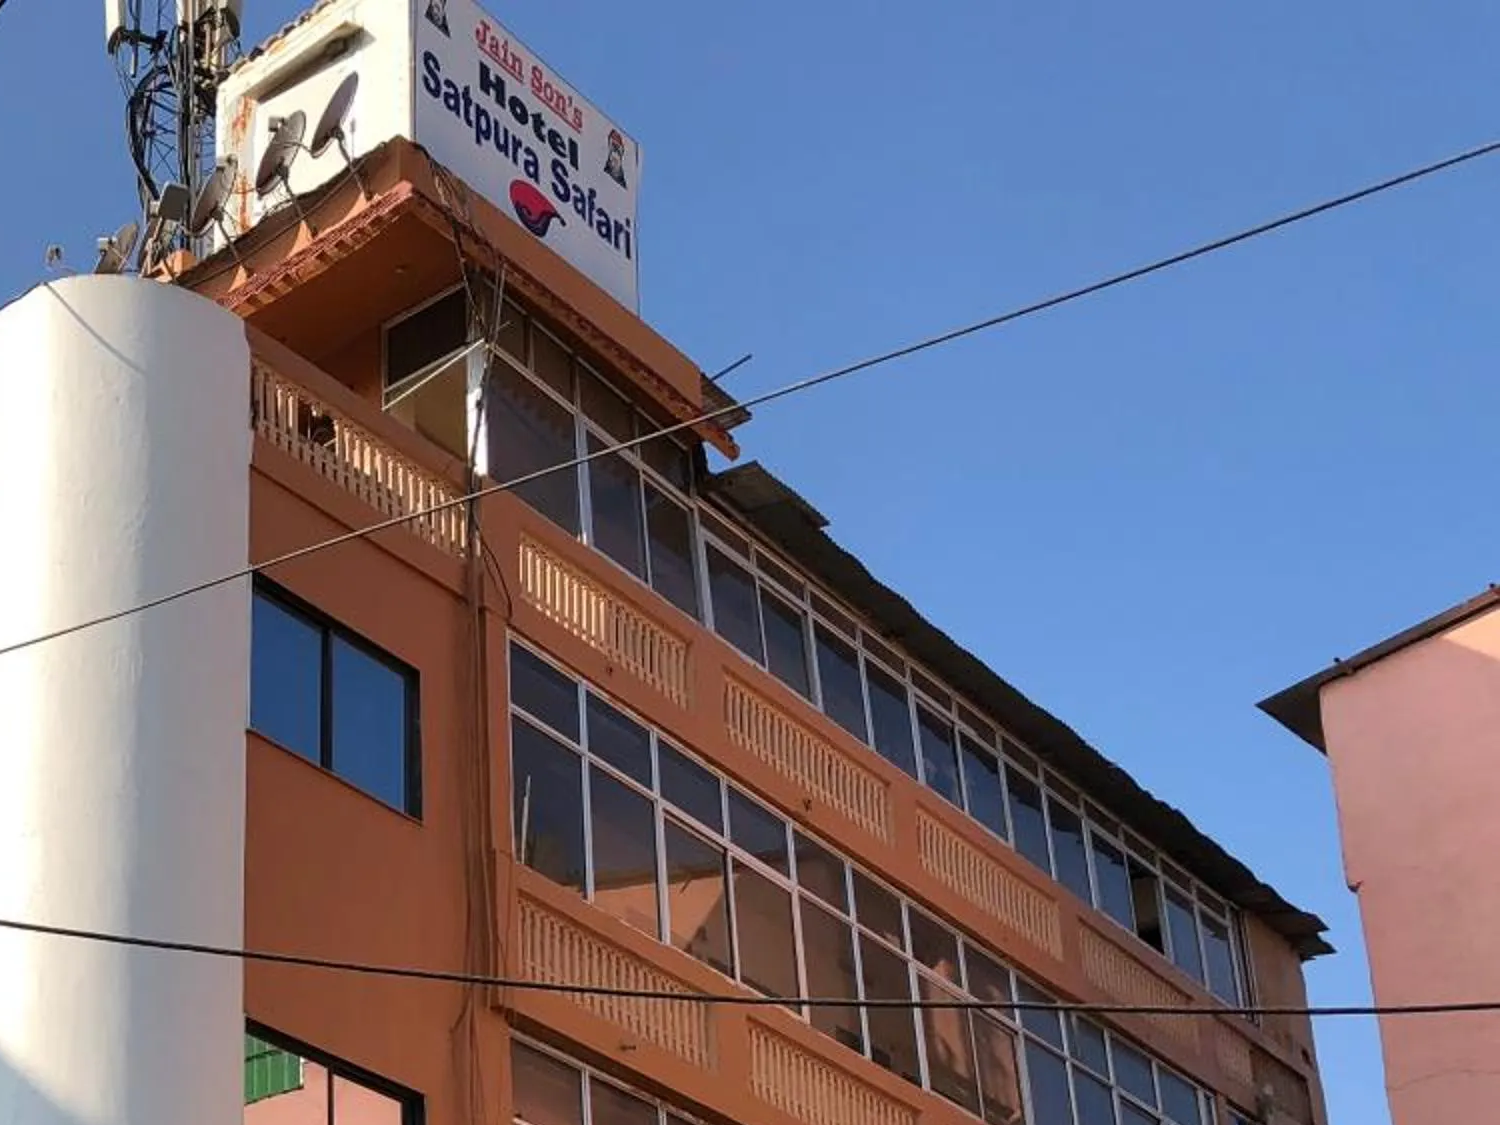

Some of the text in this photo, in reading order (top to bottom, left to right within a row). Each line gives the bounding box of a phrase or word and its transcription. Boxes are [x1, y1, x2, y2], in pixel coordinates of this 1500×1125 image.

[475, 19, 583, 130] Jain Son's
[478, 59, 579, 170] Hotel
[422, 50, 632, 260] Satpura Safari
